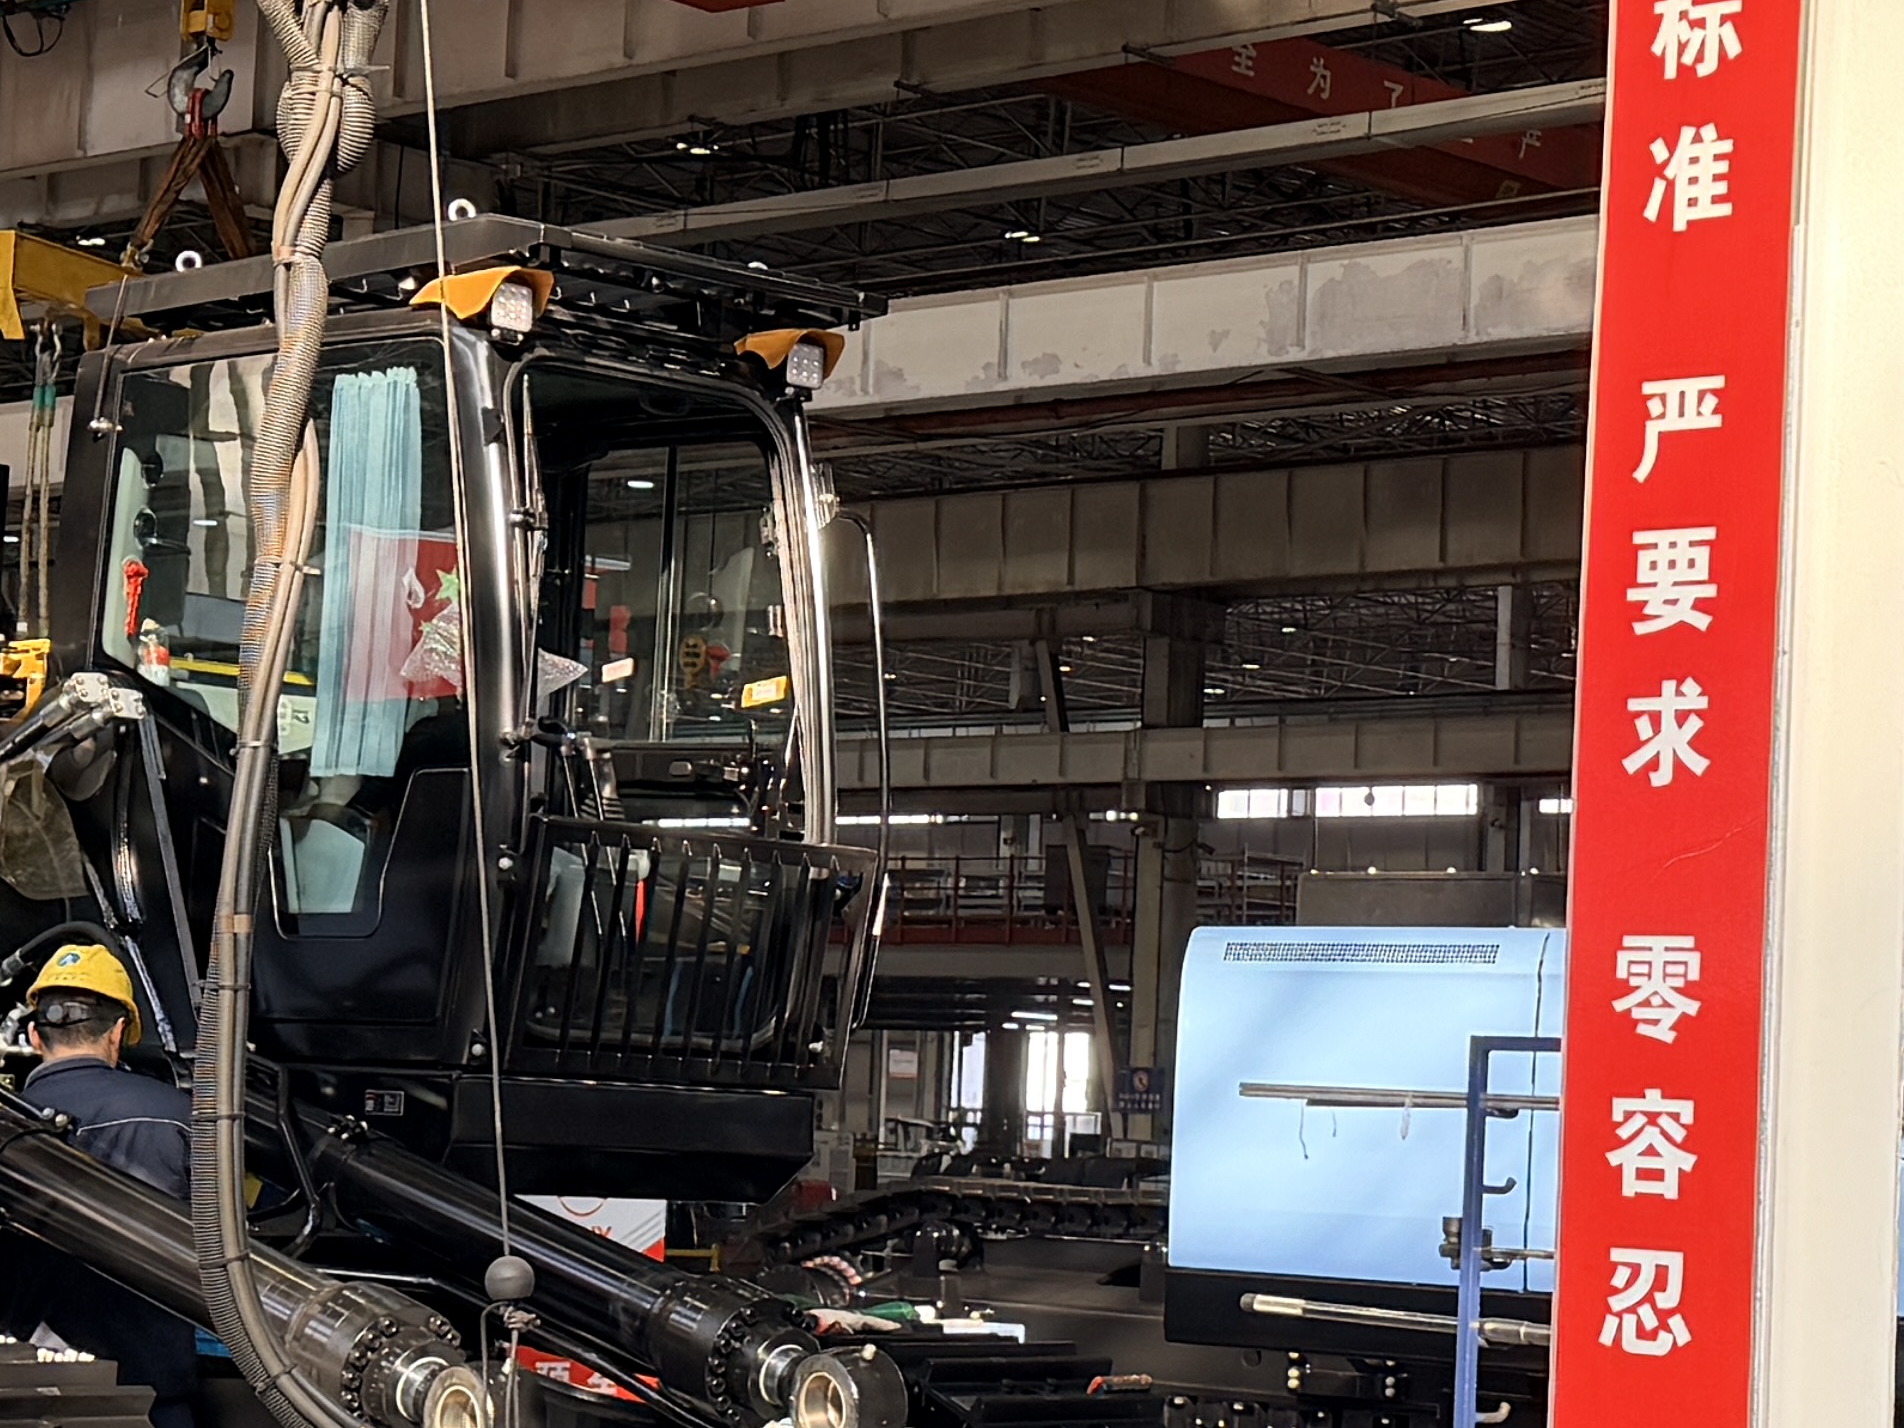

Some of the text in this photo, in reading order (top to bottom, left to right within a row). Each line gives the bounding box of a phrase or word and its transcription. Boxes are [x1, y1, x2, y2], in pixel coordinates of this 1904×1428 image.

[1621, 374, 1726, 788] 严要求
[1598, 933, 1702, 1359] 零容忍
